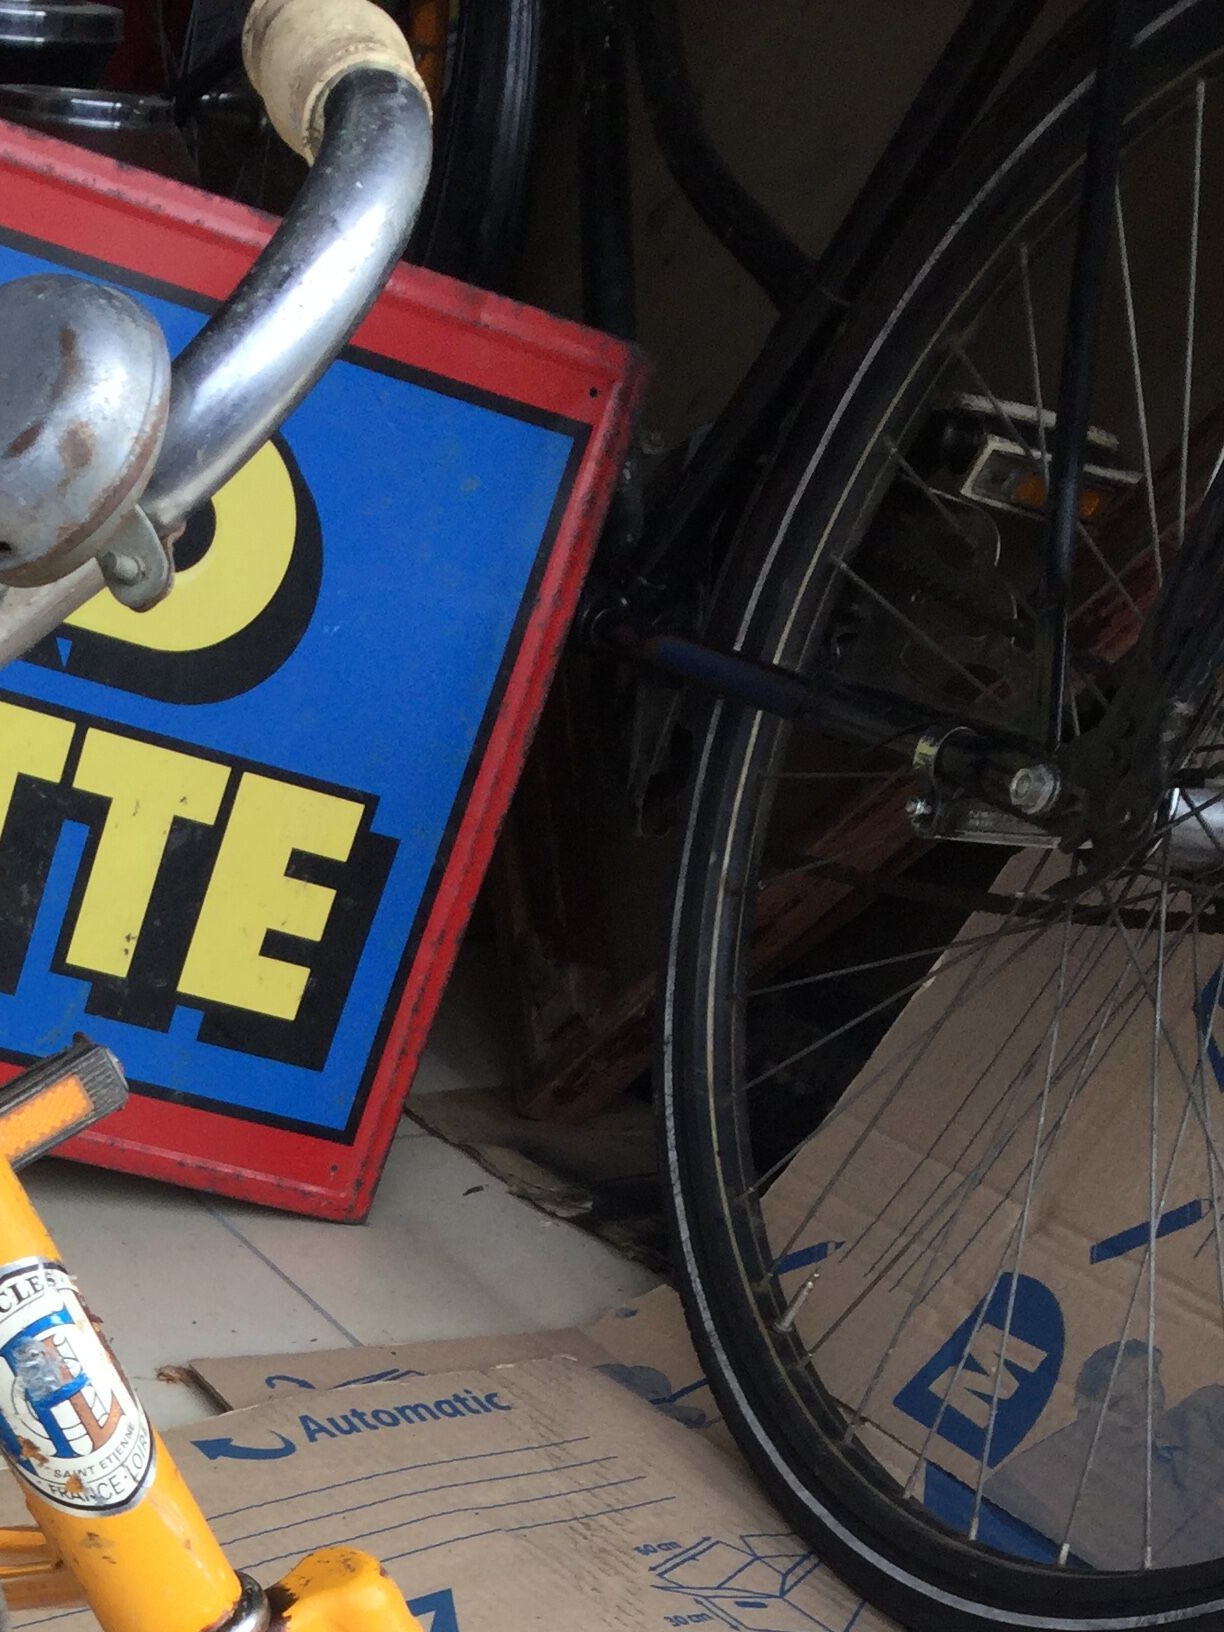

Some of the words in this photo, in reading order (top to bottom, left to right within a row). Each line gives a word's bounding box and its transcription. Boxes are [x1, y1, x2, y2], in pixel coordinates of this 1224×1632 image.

[298, 1388, 513, 1443] Automatic
[53, 1465, 96, 1479] SAINT
[657, 1541, 682, 1551] cm
[664, 1613, 689, 1627] 30
[690, 1611, 715, 1624] cm
